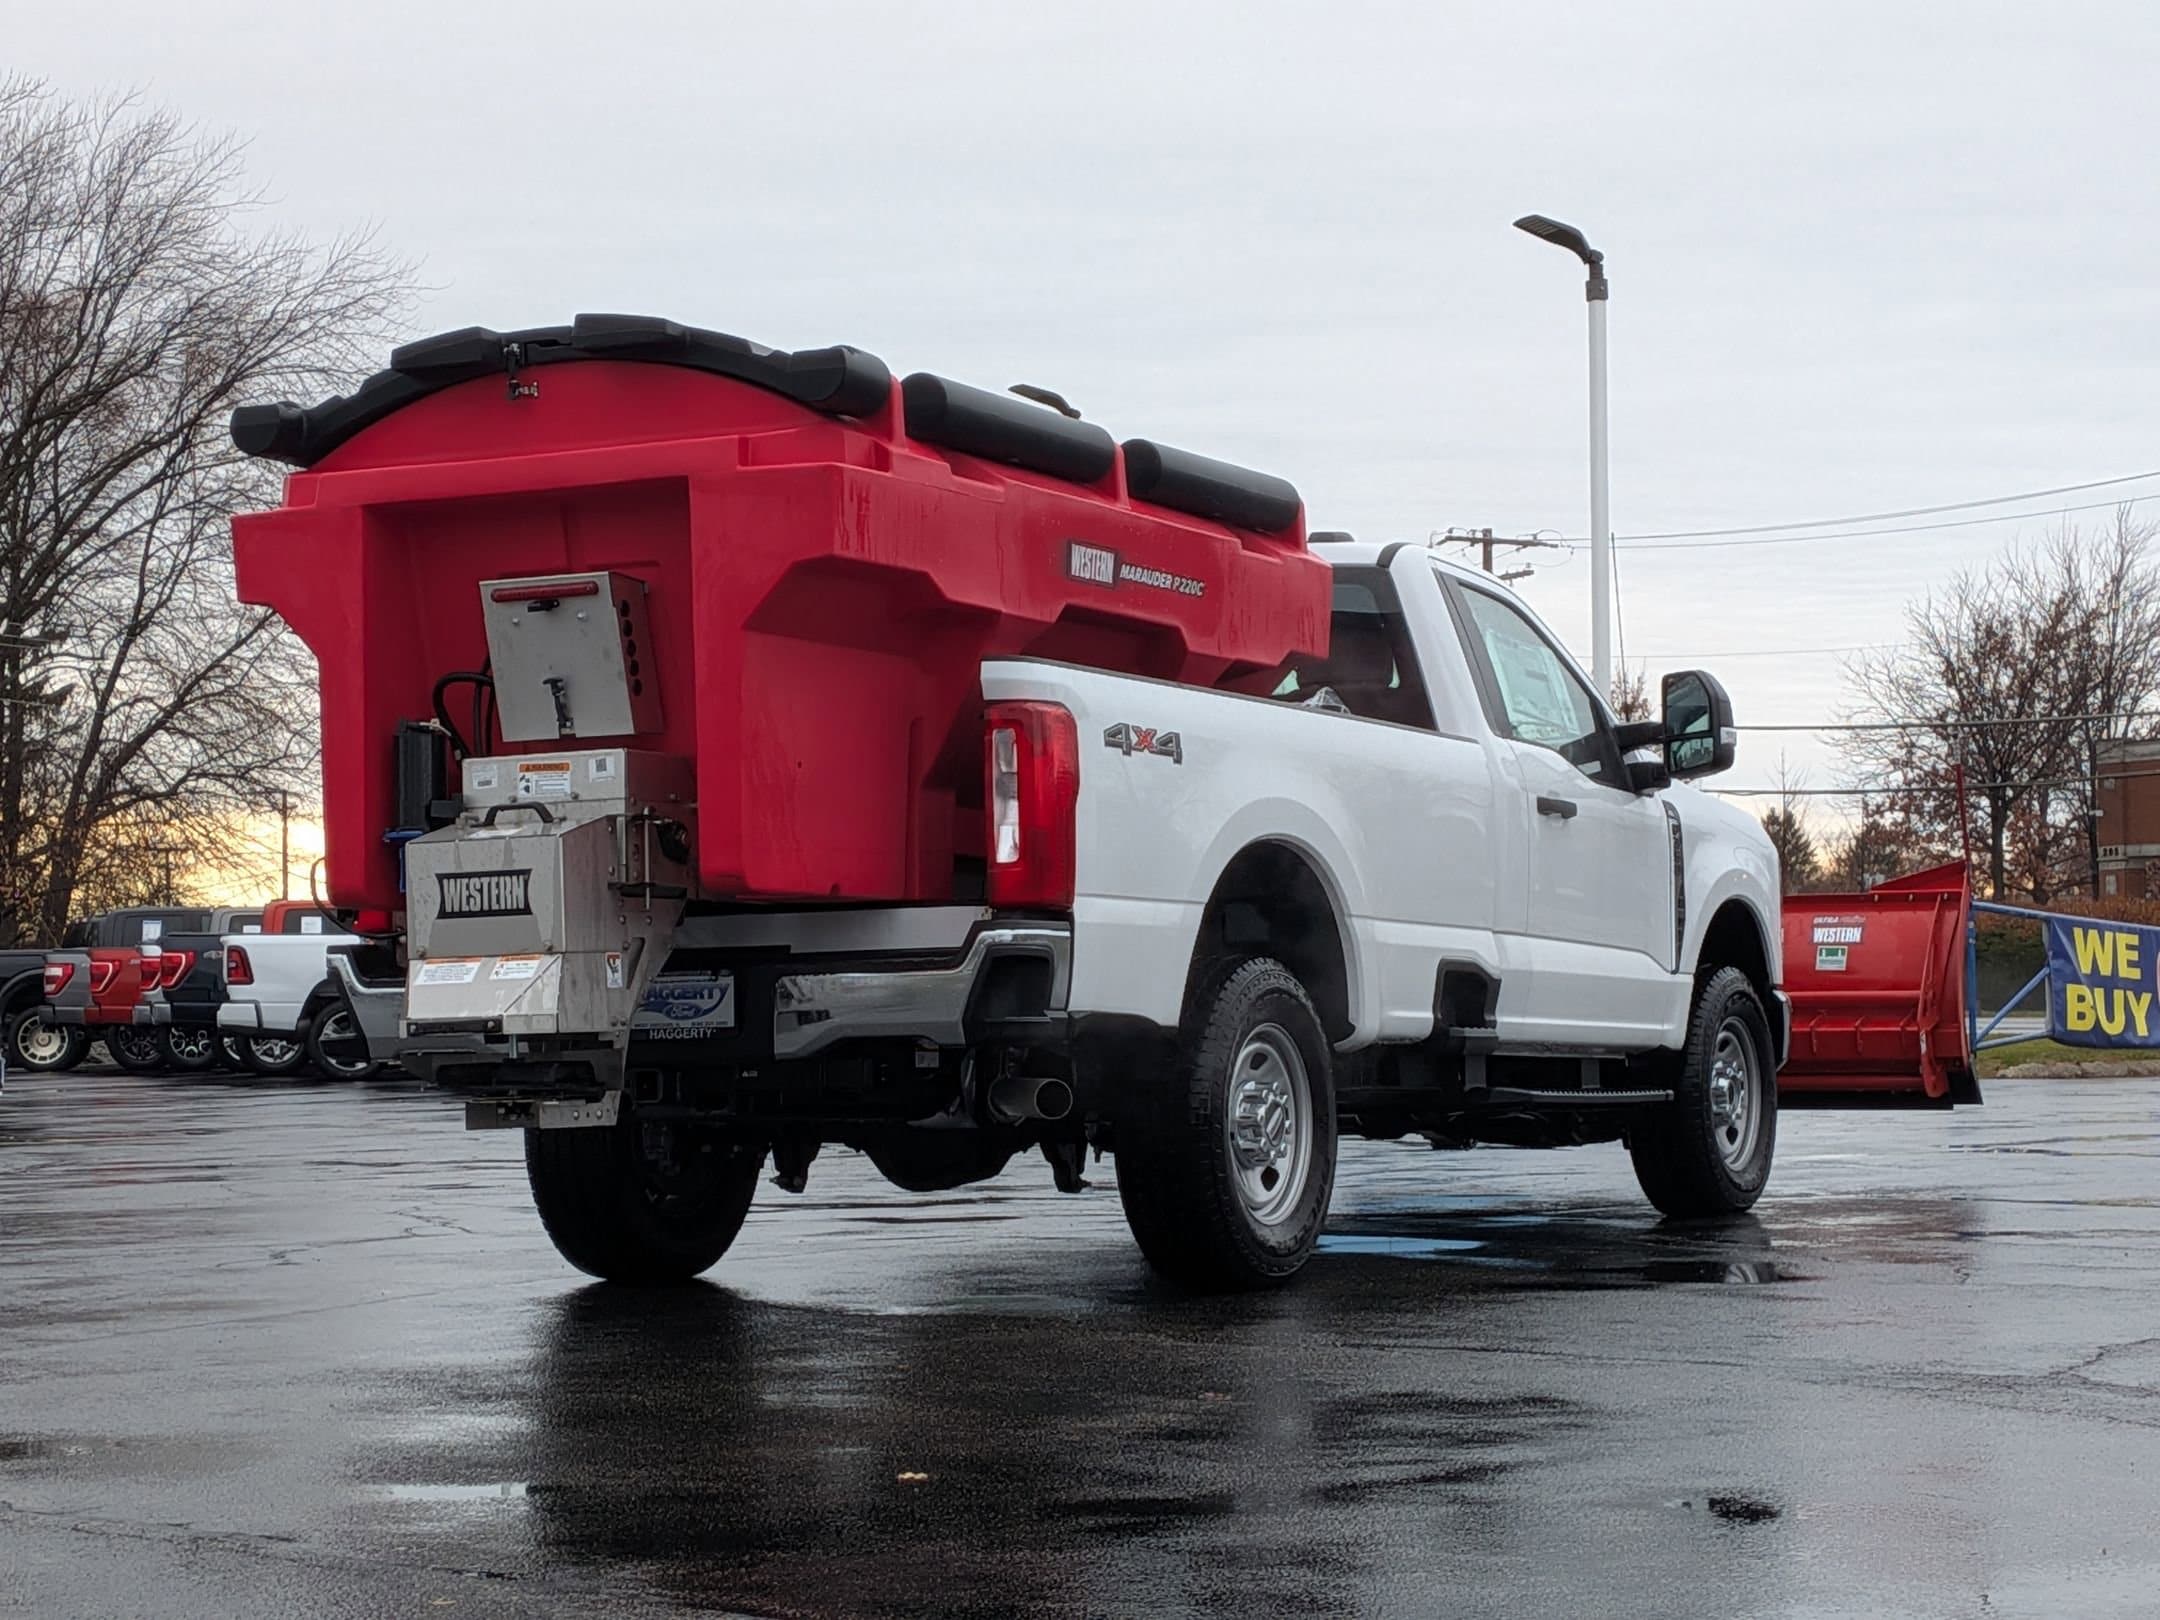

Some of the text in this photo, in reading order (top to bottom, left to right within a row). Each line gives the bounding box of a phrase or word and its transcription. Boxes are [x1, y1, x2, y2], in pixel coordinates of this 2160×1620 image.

[1071, 543, 1115, 583] WESTERN
[1119, 563, 1172, 590] MARAUDER
[443, 874, 525, 913] WESTERN
[1813, 927, 1862, 943] WESTERN
[2073, 927, 2142, 980] WE
[2066, 983, 2152, 1038] BUY
[649, 1028, 712, 1040] HAGGERTY
